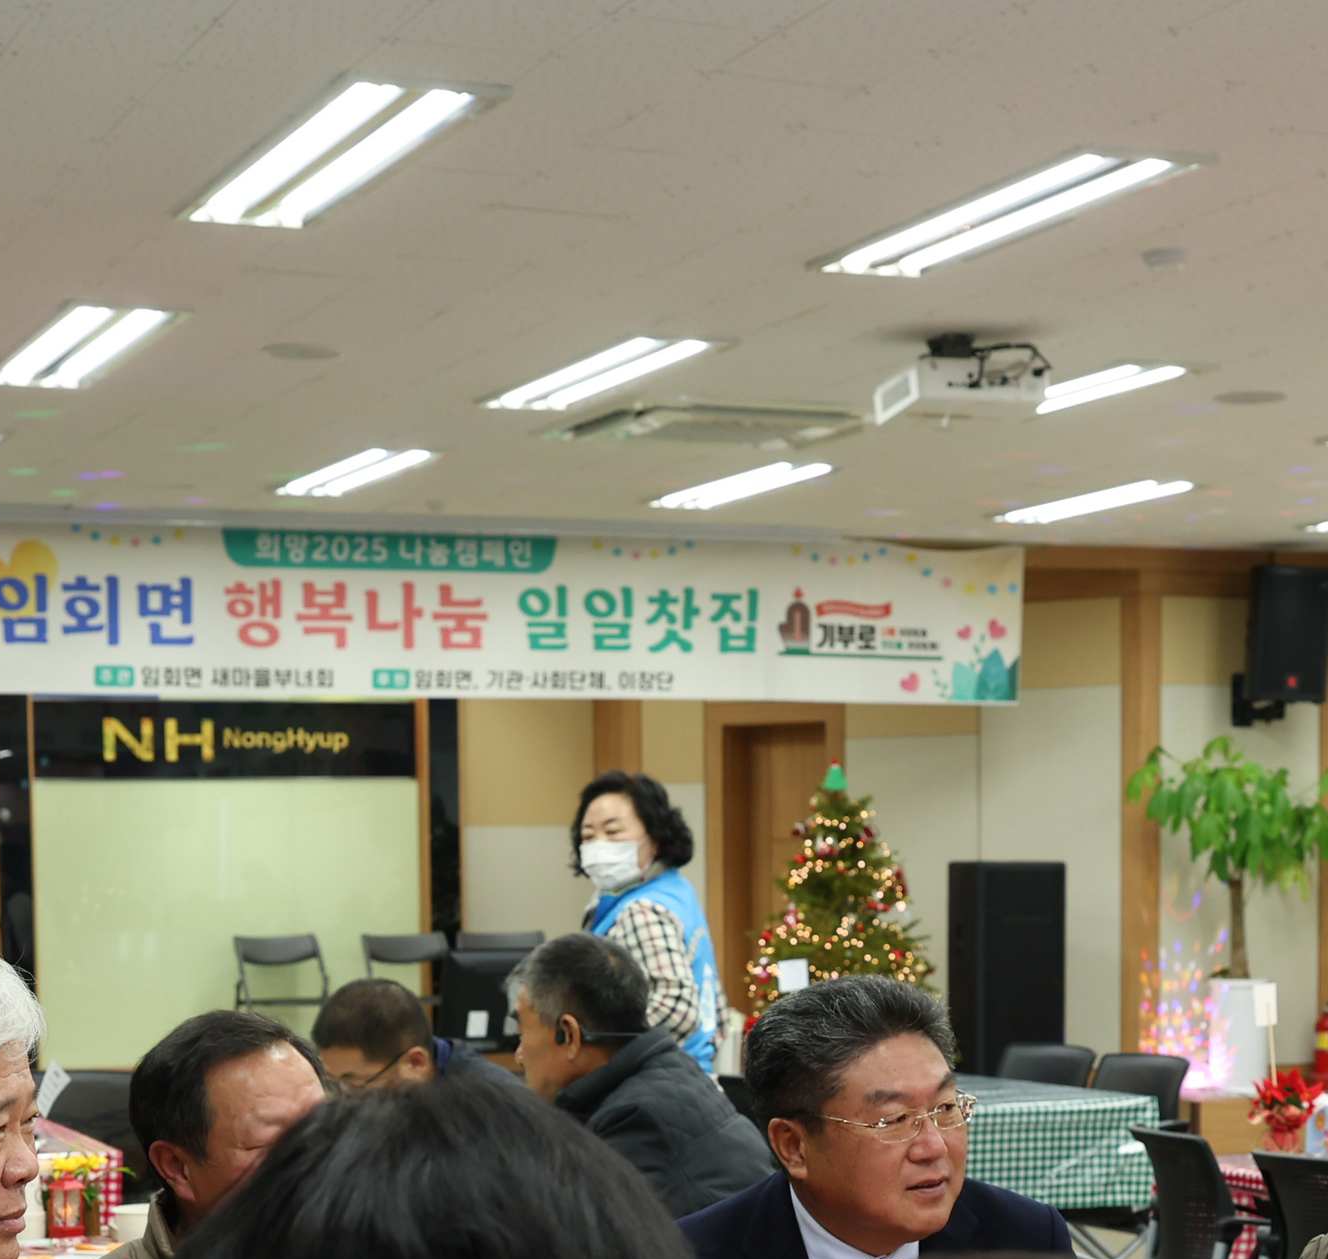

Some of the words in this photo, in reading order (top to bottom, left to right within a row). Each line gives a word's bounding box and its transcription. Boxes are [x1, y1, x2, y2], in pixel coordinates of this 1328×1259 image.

[255, 531, 389, 564] 희망2025
[398, 536, 533, 569] 나눔캠페인
[224, 577, 489, 650] 행복나눔
[518, 584, 760, 655] 일일찻집
[816, 623, 876, 651] 기부로
[141, 665, 203, 688] 임회면
[617, 670, 675, 693] 이장단
[102, 716, 216, 763] NH
[222, 726, 350, 754] NongHyup
